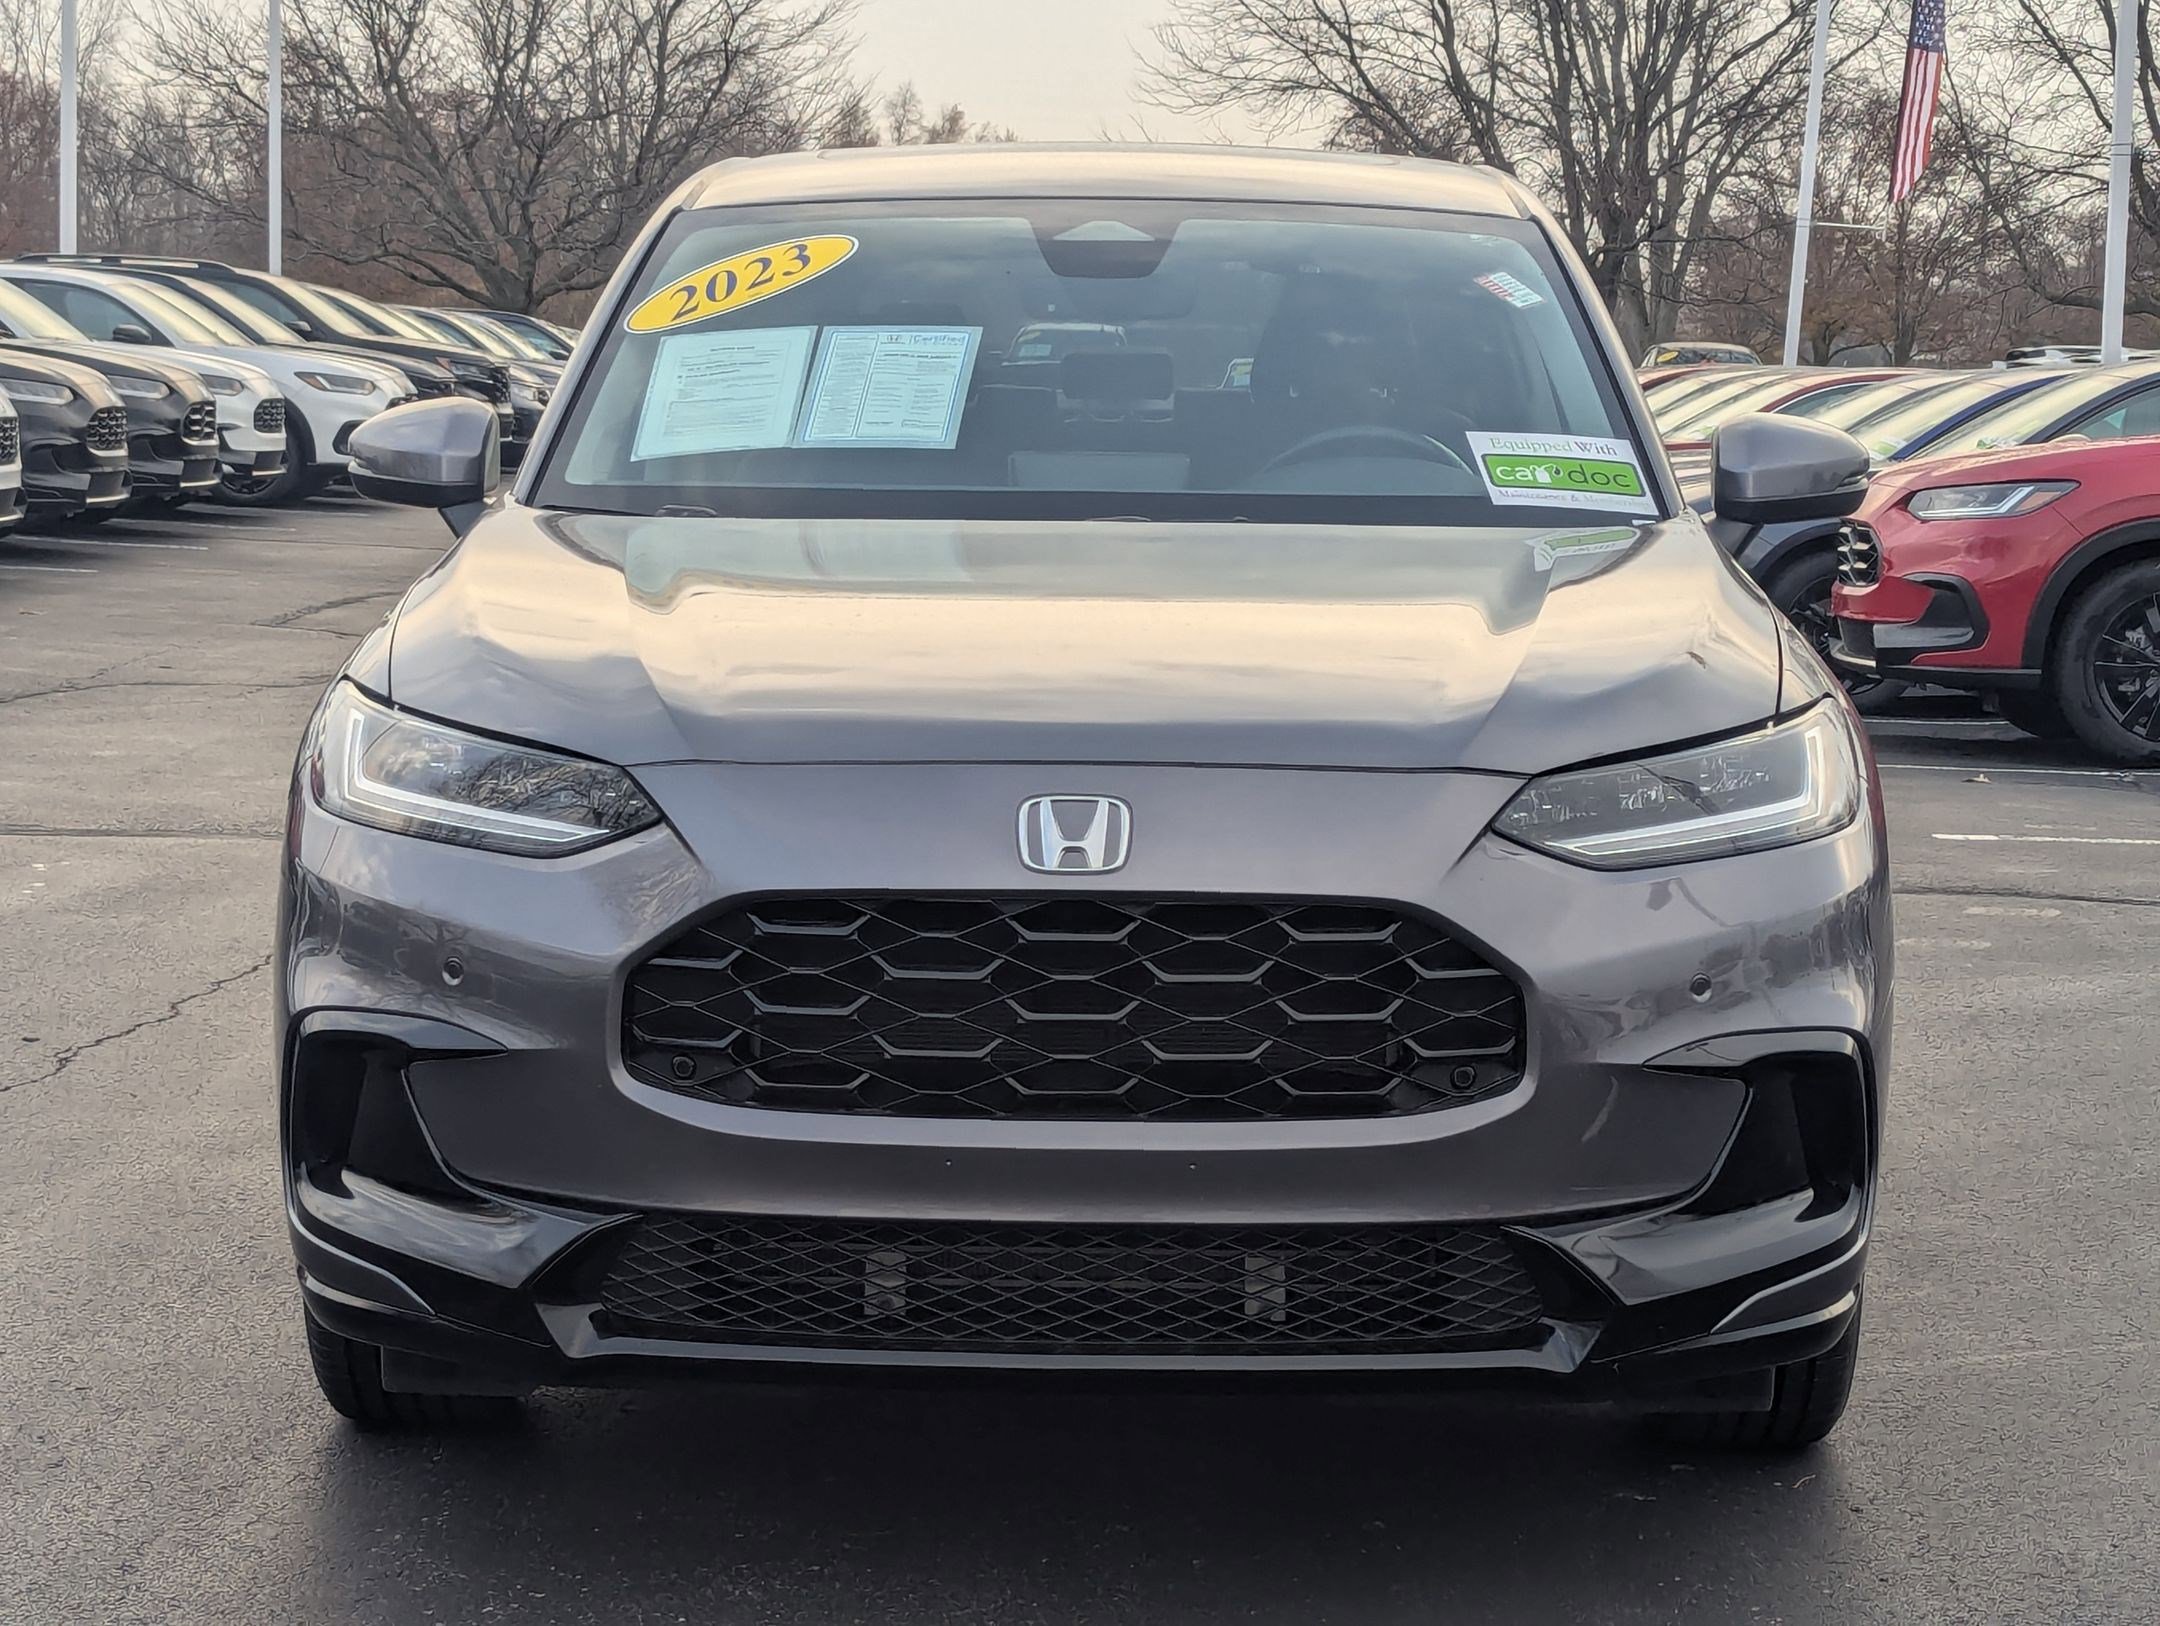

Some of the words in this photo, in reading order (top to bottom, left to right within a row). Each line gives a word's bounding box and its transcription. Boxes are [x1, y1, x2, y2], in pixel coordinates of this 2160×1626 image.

[669, 243, 811, 322] 2023
[1488, 437, 1573, 453] Equipped
[1573, 440, 1618, 457] With
[1567, 464, 1631, 488] doc
